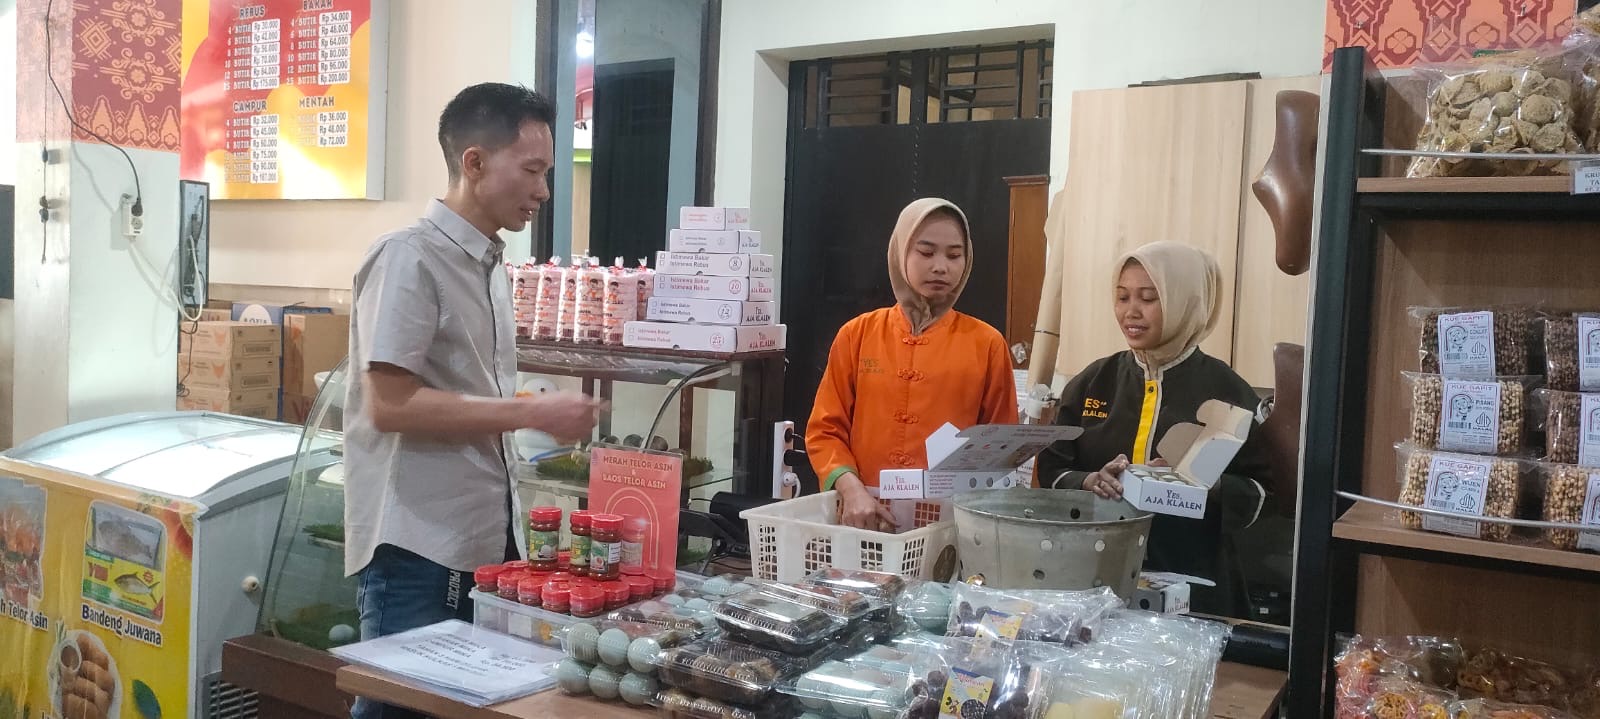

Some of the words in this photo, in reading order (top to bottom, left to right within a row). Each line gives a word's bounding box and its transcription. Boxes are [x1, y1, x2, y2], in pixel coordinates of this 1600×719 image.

[303, 0, 332, 10] BAKAR
[240, 7, 265, 18] REBUS
[322, 14, 329, 23] Rp
[321, 27, 328, 35] Rp
[254, 34, 260, 42] Rp
[321, 40, 328, 48] Rp
[254, 46, 260, 54] Rp
[321, 52, 328, 60] Rp
[254, 57, 260, 65] Rp
[254, 68, 260, 76] Rp
[321, 64, 327, 72] Rp
[234, 101, 266, 111] CAMPUR
[299, 97, 334, 108] MENTAH
[253, 117, 259, 125] Rp
[320, 114, 327, 122] Rp
[320, 126, 327, 134] Rp
[253, 140, 259, 148] Rp
[253, 152, 259, 160] Rp
[253, 163, 259, 171] Rp
[252, 174, 259, 182] Rp
[603, 456, 628, 466] MERAH
[630, 458, 652, 469] TELOR
[654, 463, 672, 472] ASIN
[624, 476, 646, 487] TELOR
[647, 480, 666, 488] ASIN
[1145, 496, 1164, 505] AJA
[1166, 499, 1202, 510] KLALEN
[8, 602, 28, 621] Telor
[29, 613, 48, 629] Asin
[82, 604, 122, 634] Bandeng
[124, 622, 162, 645] Juwana
